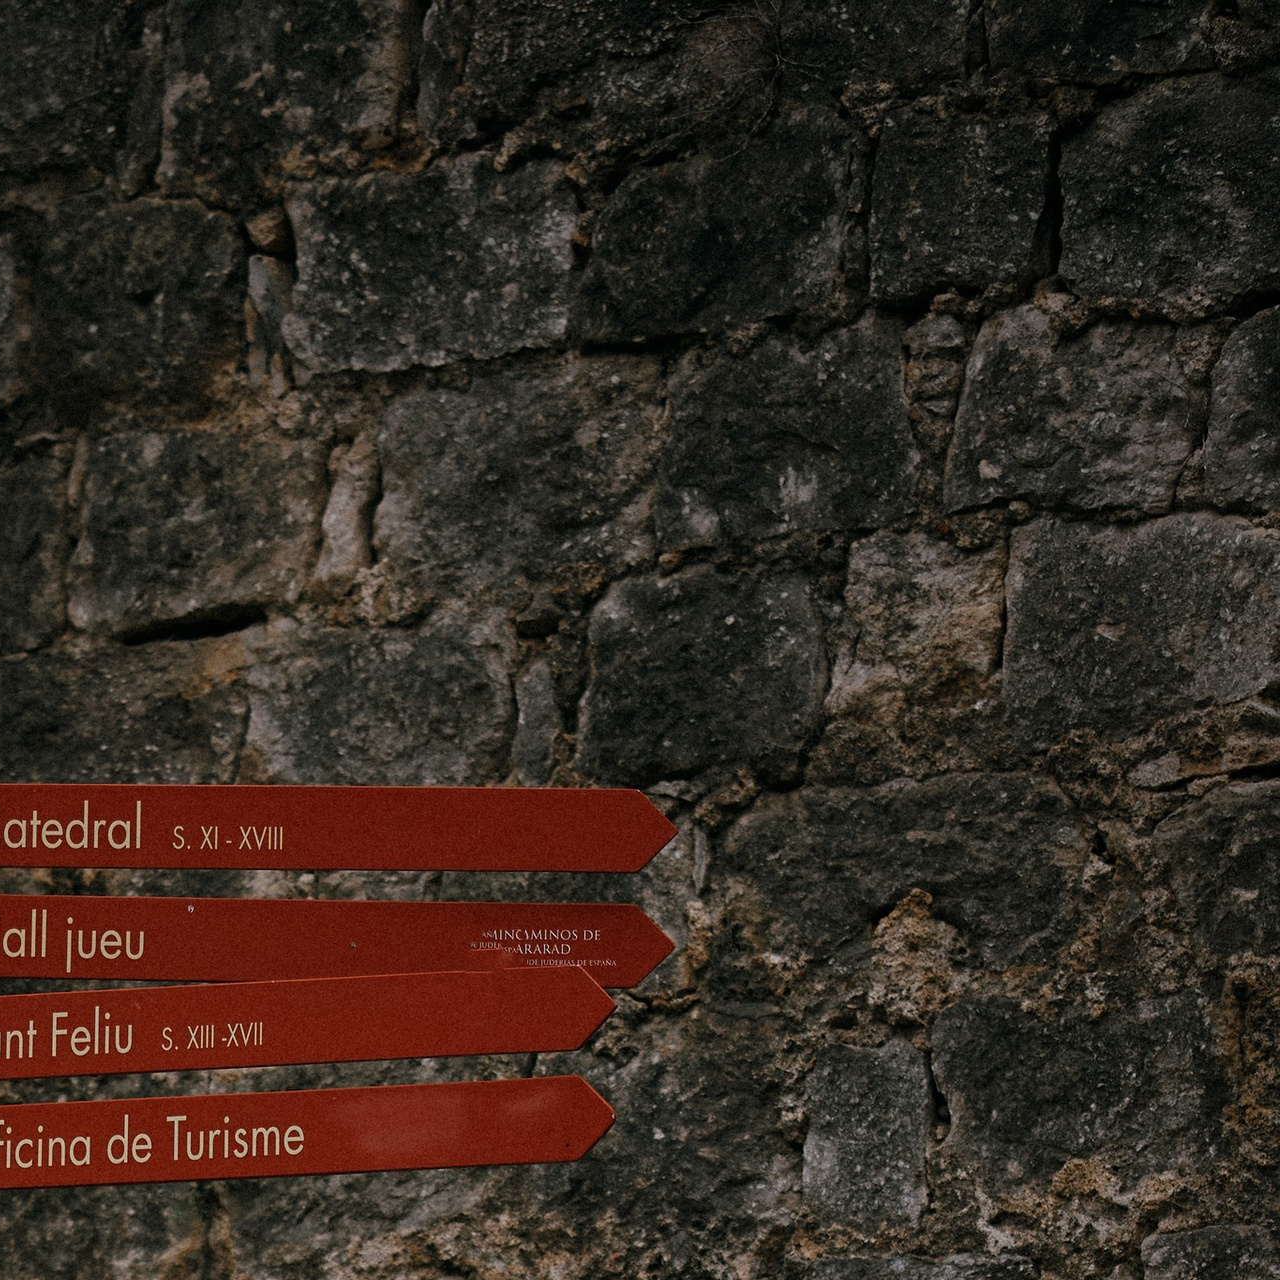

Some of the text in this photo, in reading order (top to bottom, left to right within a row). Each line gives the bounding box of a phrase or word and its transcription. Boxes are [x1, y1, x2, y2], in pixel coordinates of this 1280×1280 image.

[200, 825, 219, 850] XI
[238, 826, 283, 851] XVIII
[66, 916, 145, 974] jueu
[51, 1005, 133, 1057] Feliu
[186, 1024, 215, 1050] XIII
[106, 1113, 153, 1165] de
[166, 1115, 305, 1161] Turisme
